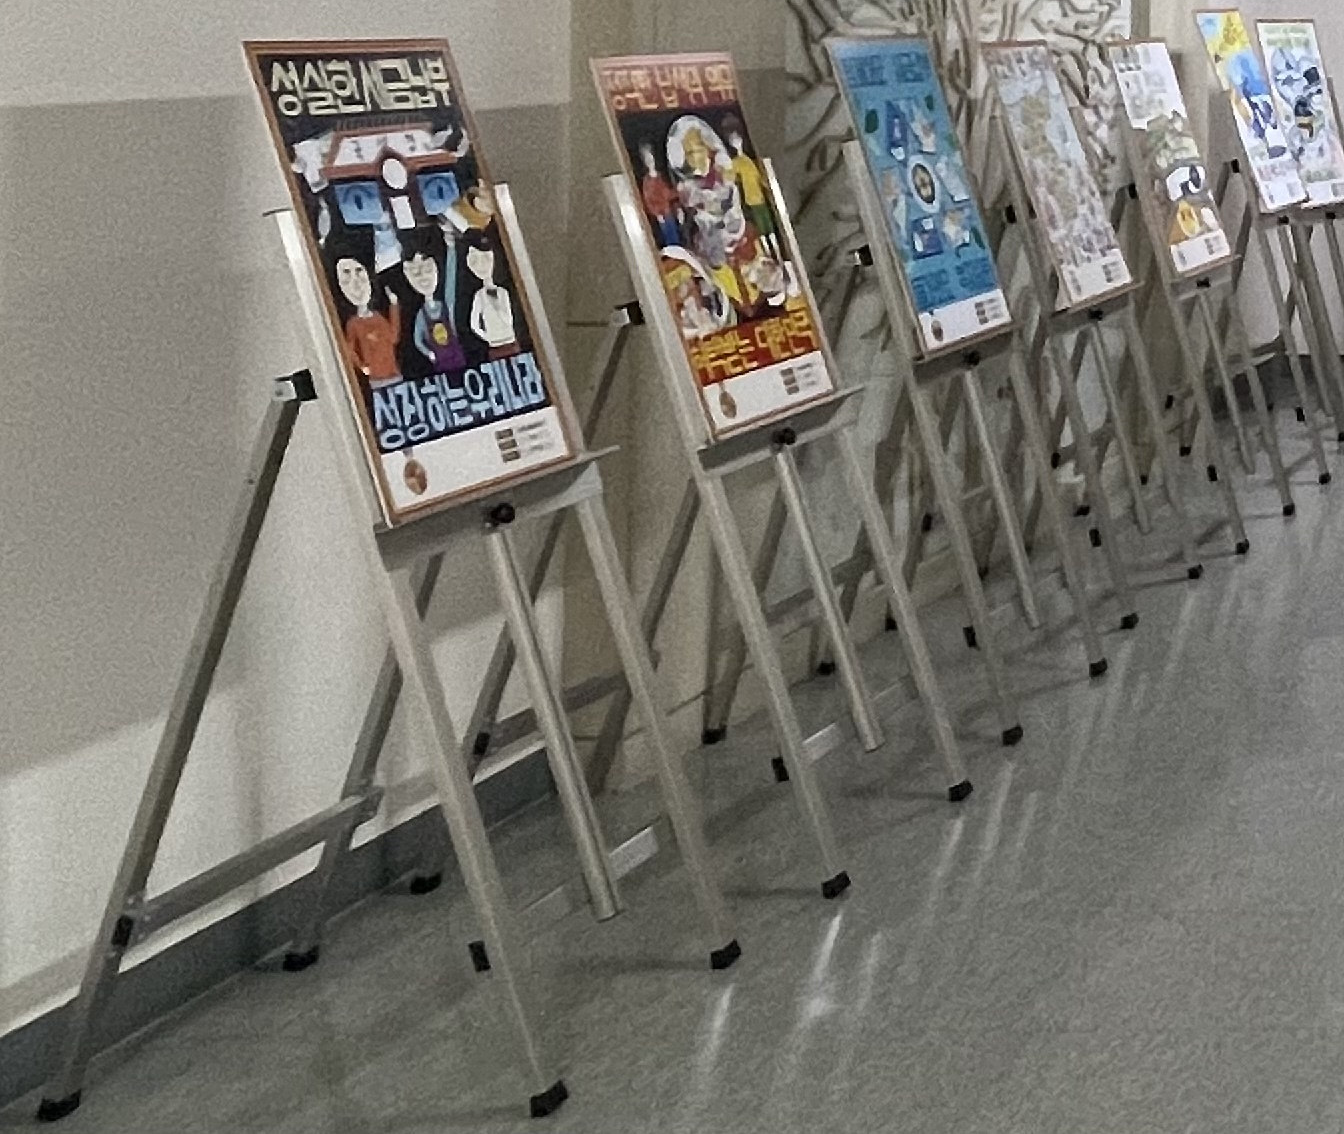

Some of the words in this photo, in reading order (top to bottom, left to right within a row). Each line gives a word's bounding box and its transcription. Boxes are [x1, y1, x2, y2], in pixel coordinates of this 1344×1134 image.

[270, 59, 366, 116] 성실한
[358, 57, 450, 111] 세금납부
[372, 373, 474, 450] 성장하는
[464, 352, 547, 421] 우리나라
